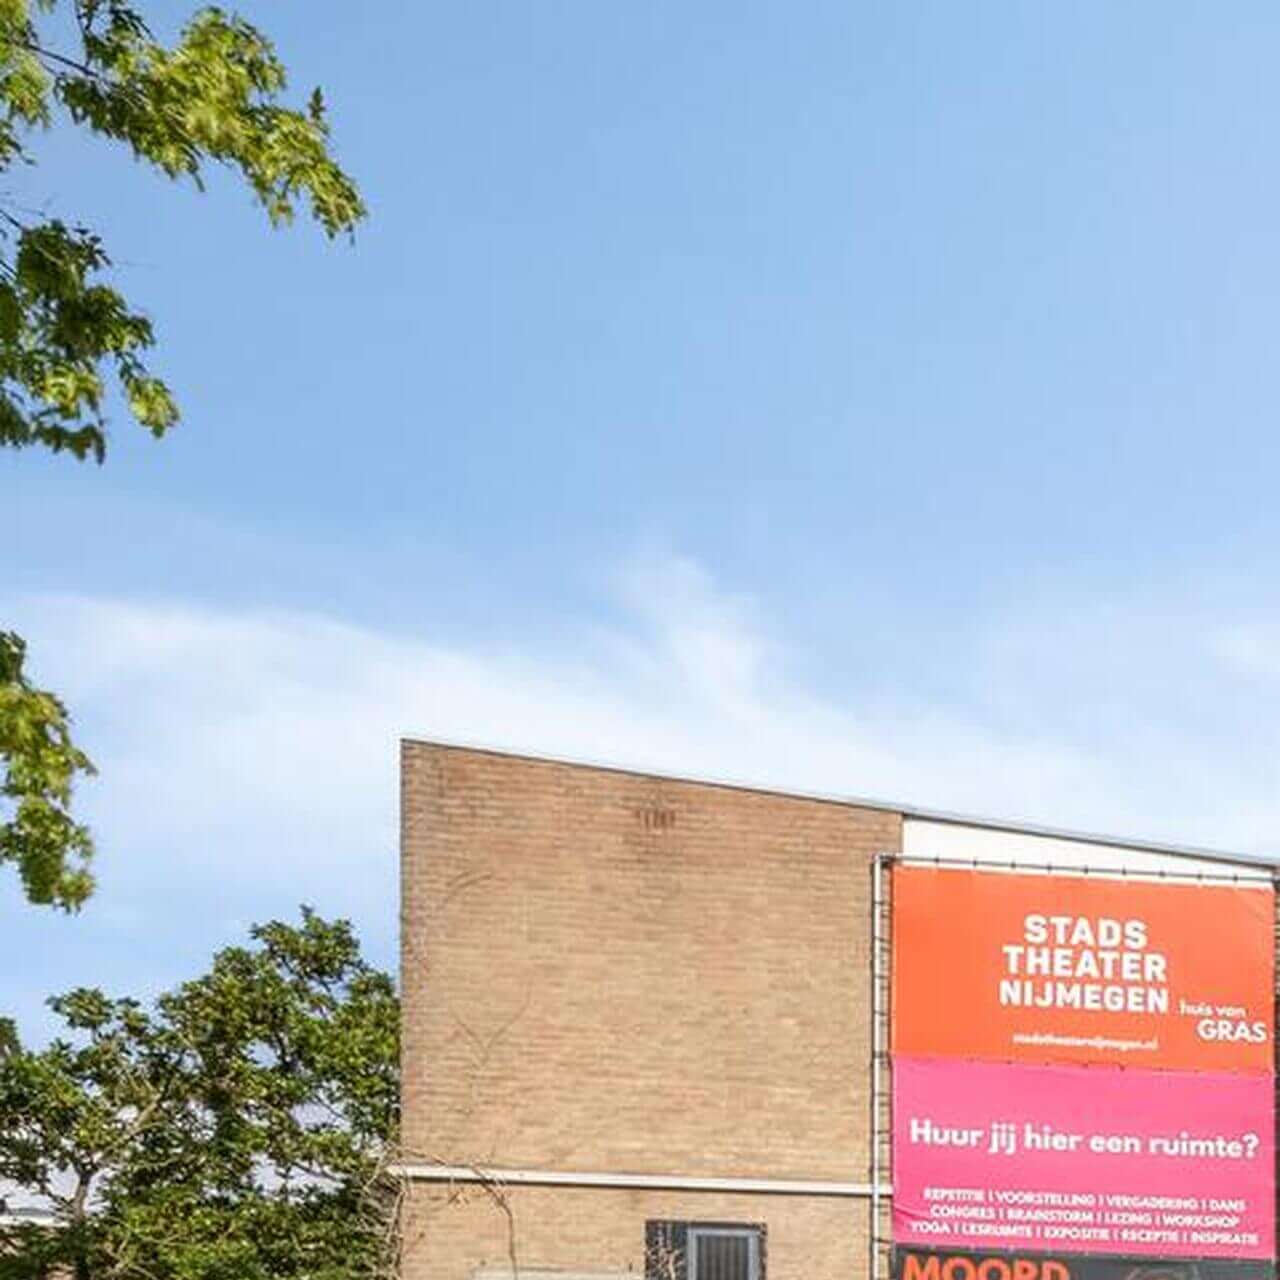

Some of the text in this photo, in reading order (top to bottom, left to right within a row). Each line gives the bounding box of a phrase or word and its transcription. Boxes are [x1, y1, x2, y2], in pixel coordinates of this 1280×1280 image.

[1024, 914, 1148, 949] STADS
[1002, 945, 1167, 982] THEATER
[1000, 980, 1169, 1014] NIJMEGEN
[1179, 1000, 1247, 1018] huis van
[1197, 1019, 1267, 1043] GRAS
[910, 1119, 1260, 1158] Huur jij hier een ruimte?
[1209, 1198, 1246, 1211] DANS
[911, 1221, 950, 1234] YOGA
[1163, 1214, 1240, 1228] WORKSHOP
